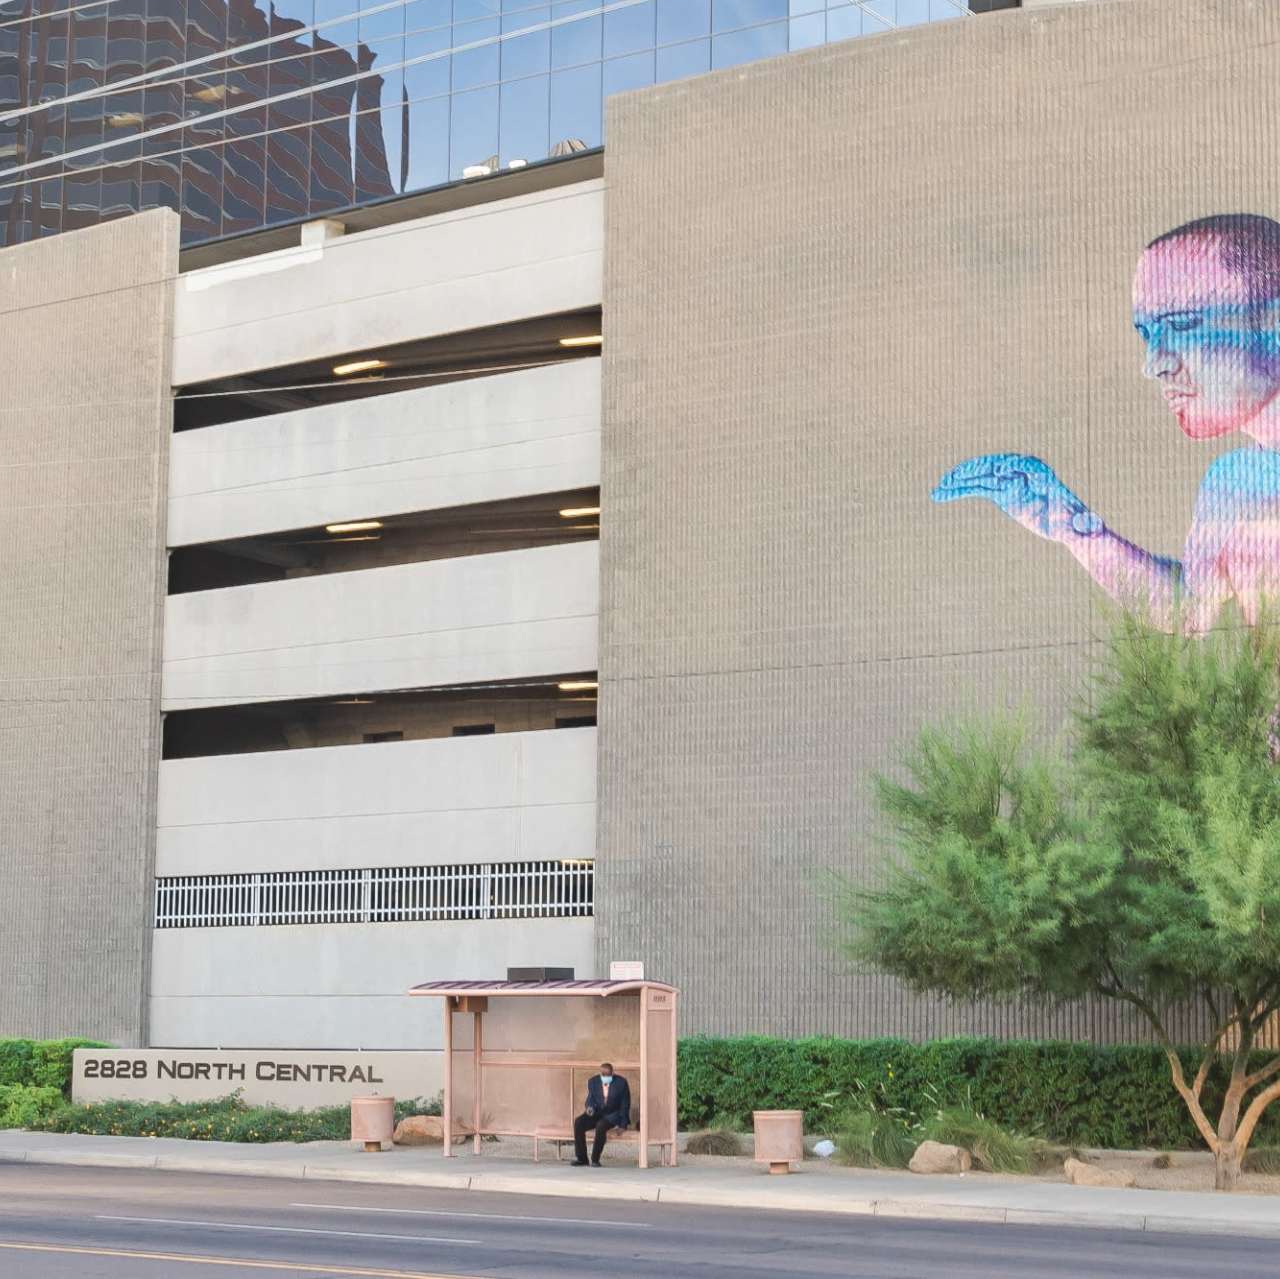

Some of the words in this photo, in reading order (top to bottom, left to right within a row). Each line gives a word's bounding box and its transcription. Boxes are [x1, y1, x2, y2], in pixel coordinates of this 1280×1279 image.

[83, 1059, 148, 1079] 2828
[157, 1060, 246, 1081] NORTH
[255, 1061, 384, 1083] CENTRAL
